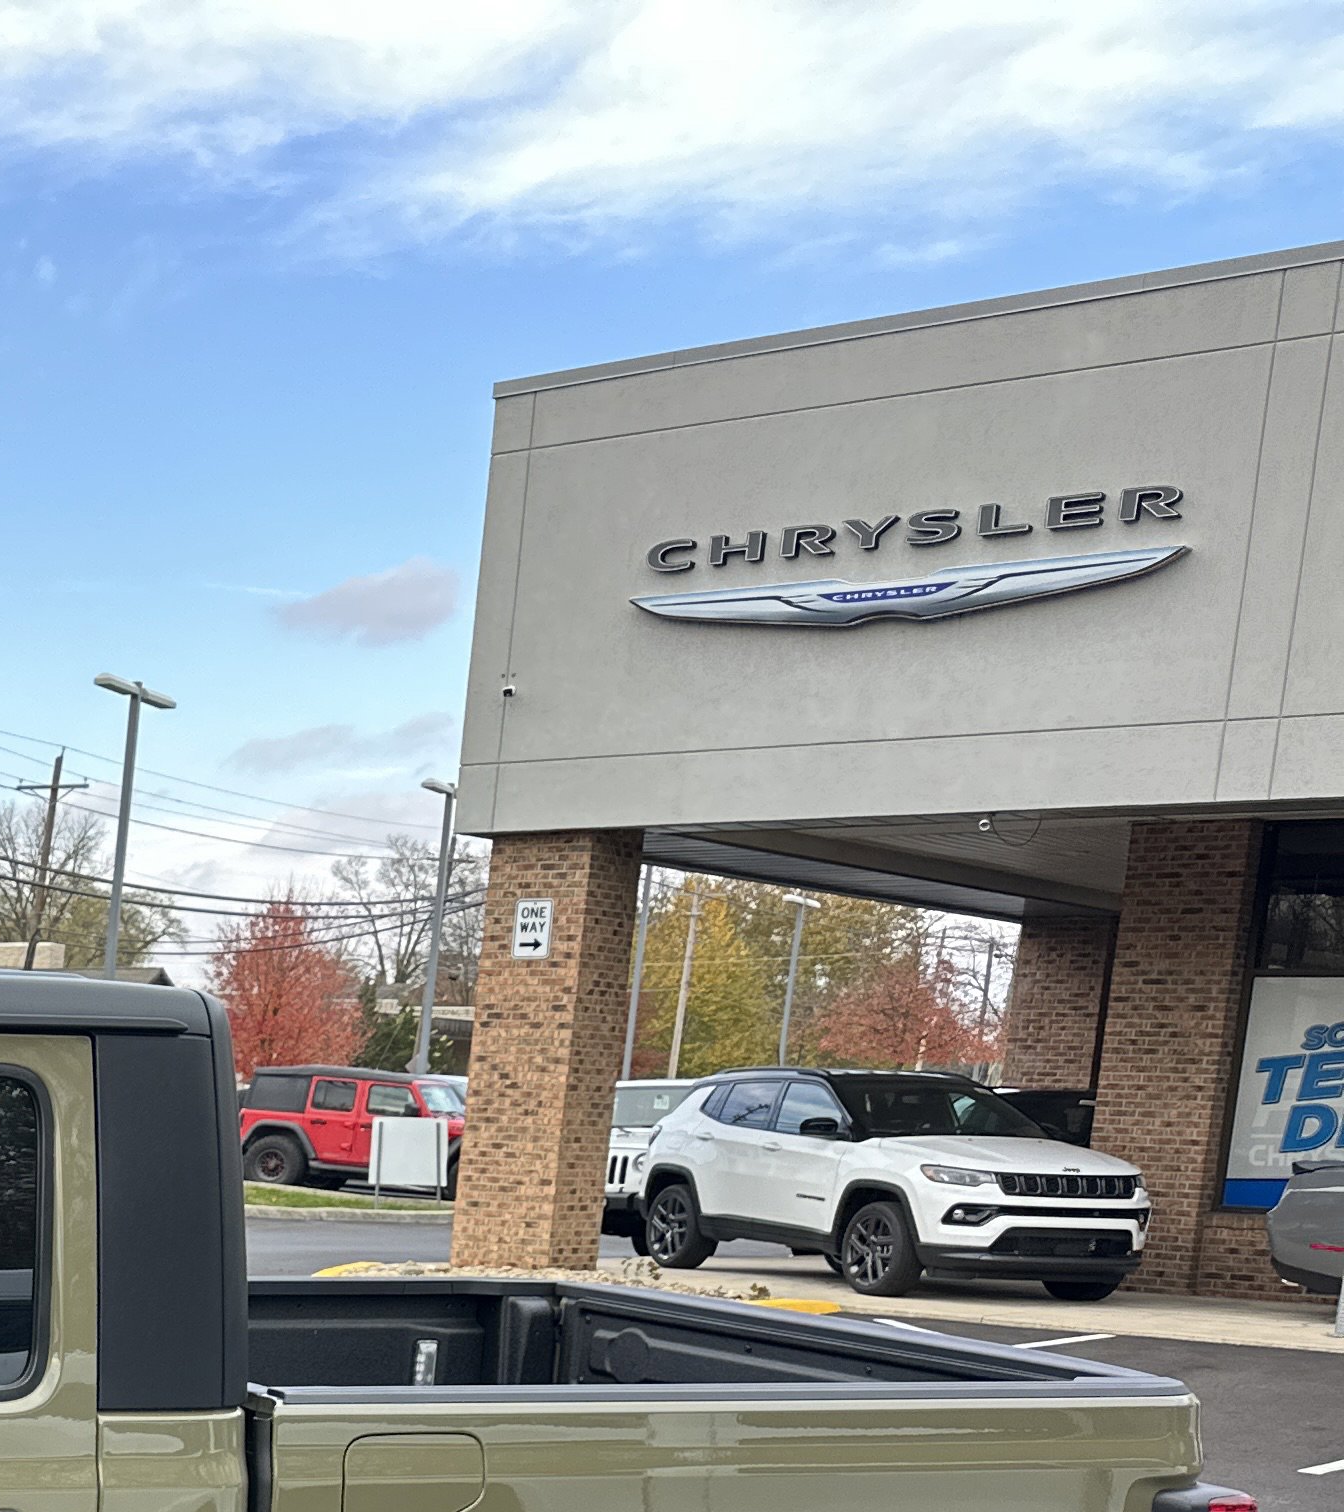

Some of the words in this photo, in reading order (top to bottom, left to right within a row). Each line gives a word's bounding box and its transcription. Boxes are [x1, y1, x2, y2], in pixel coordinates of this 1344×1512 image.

[645, 484, 1185, 573] CHRYSLER
[832, 586, 938, 601] CHRYSLER
[521, 906, 547, 919] ONE
[520, 921, 546, 933] WAY
